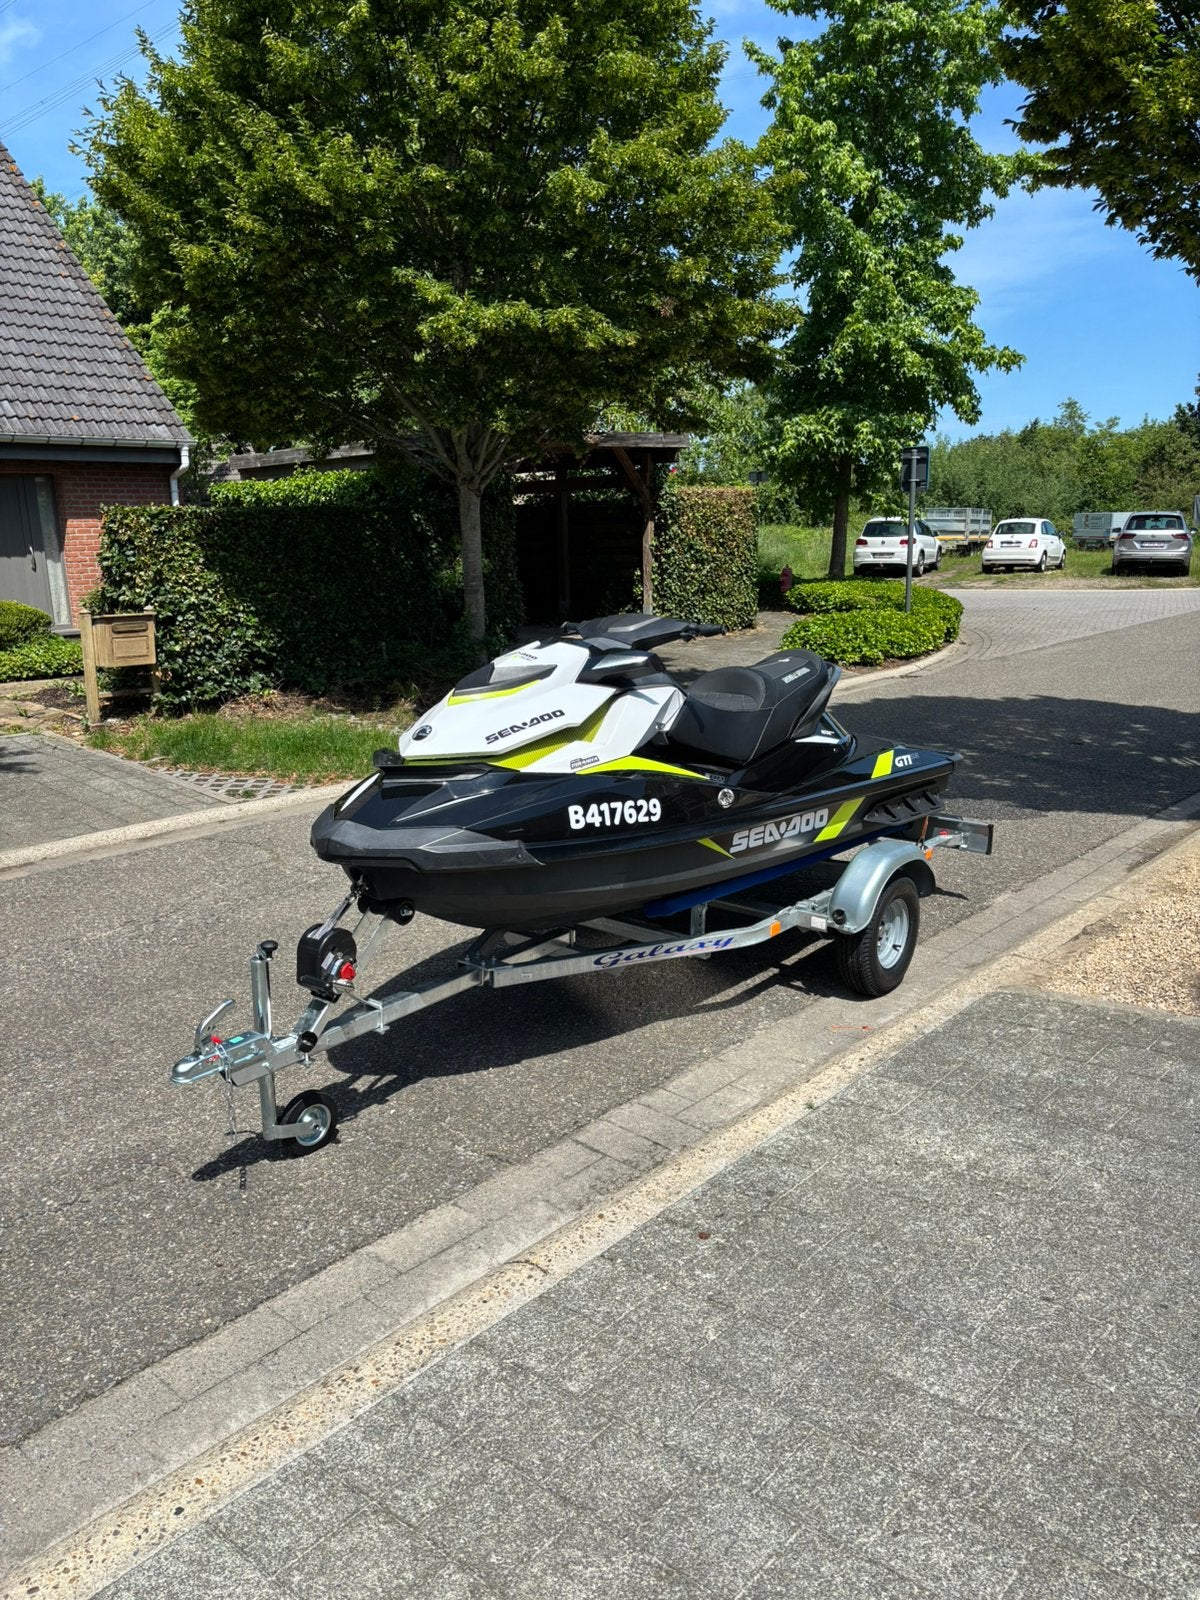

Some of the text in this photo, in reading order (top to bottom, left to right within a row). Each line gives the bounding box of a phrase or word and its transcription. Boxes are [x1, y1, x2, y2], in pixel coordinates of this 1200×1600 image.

[894, 754, 912, 767] GTI
[568, 798, 661, 829] B417629
[593, 936, 734, 968] Galaxy
